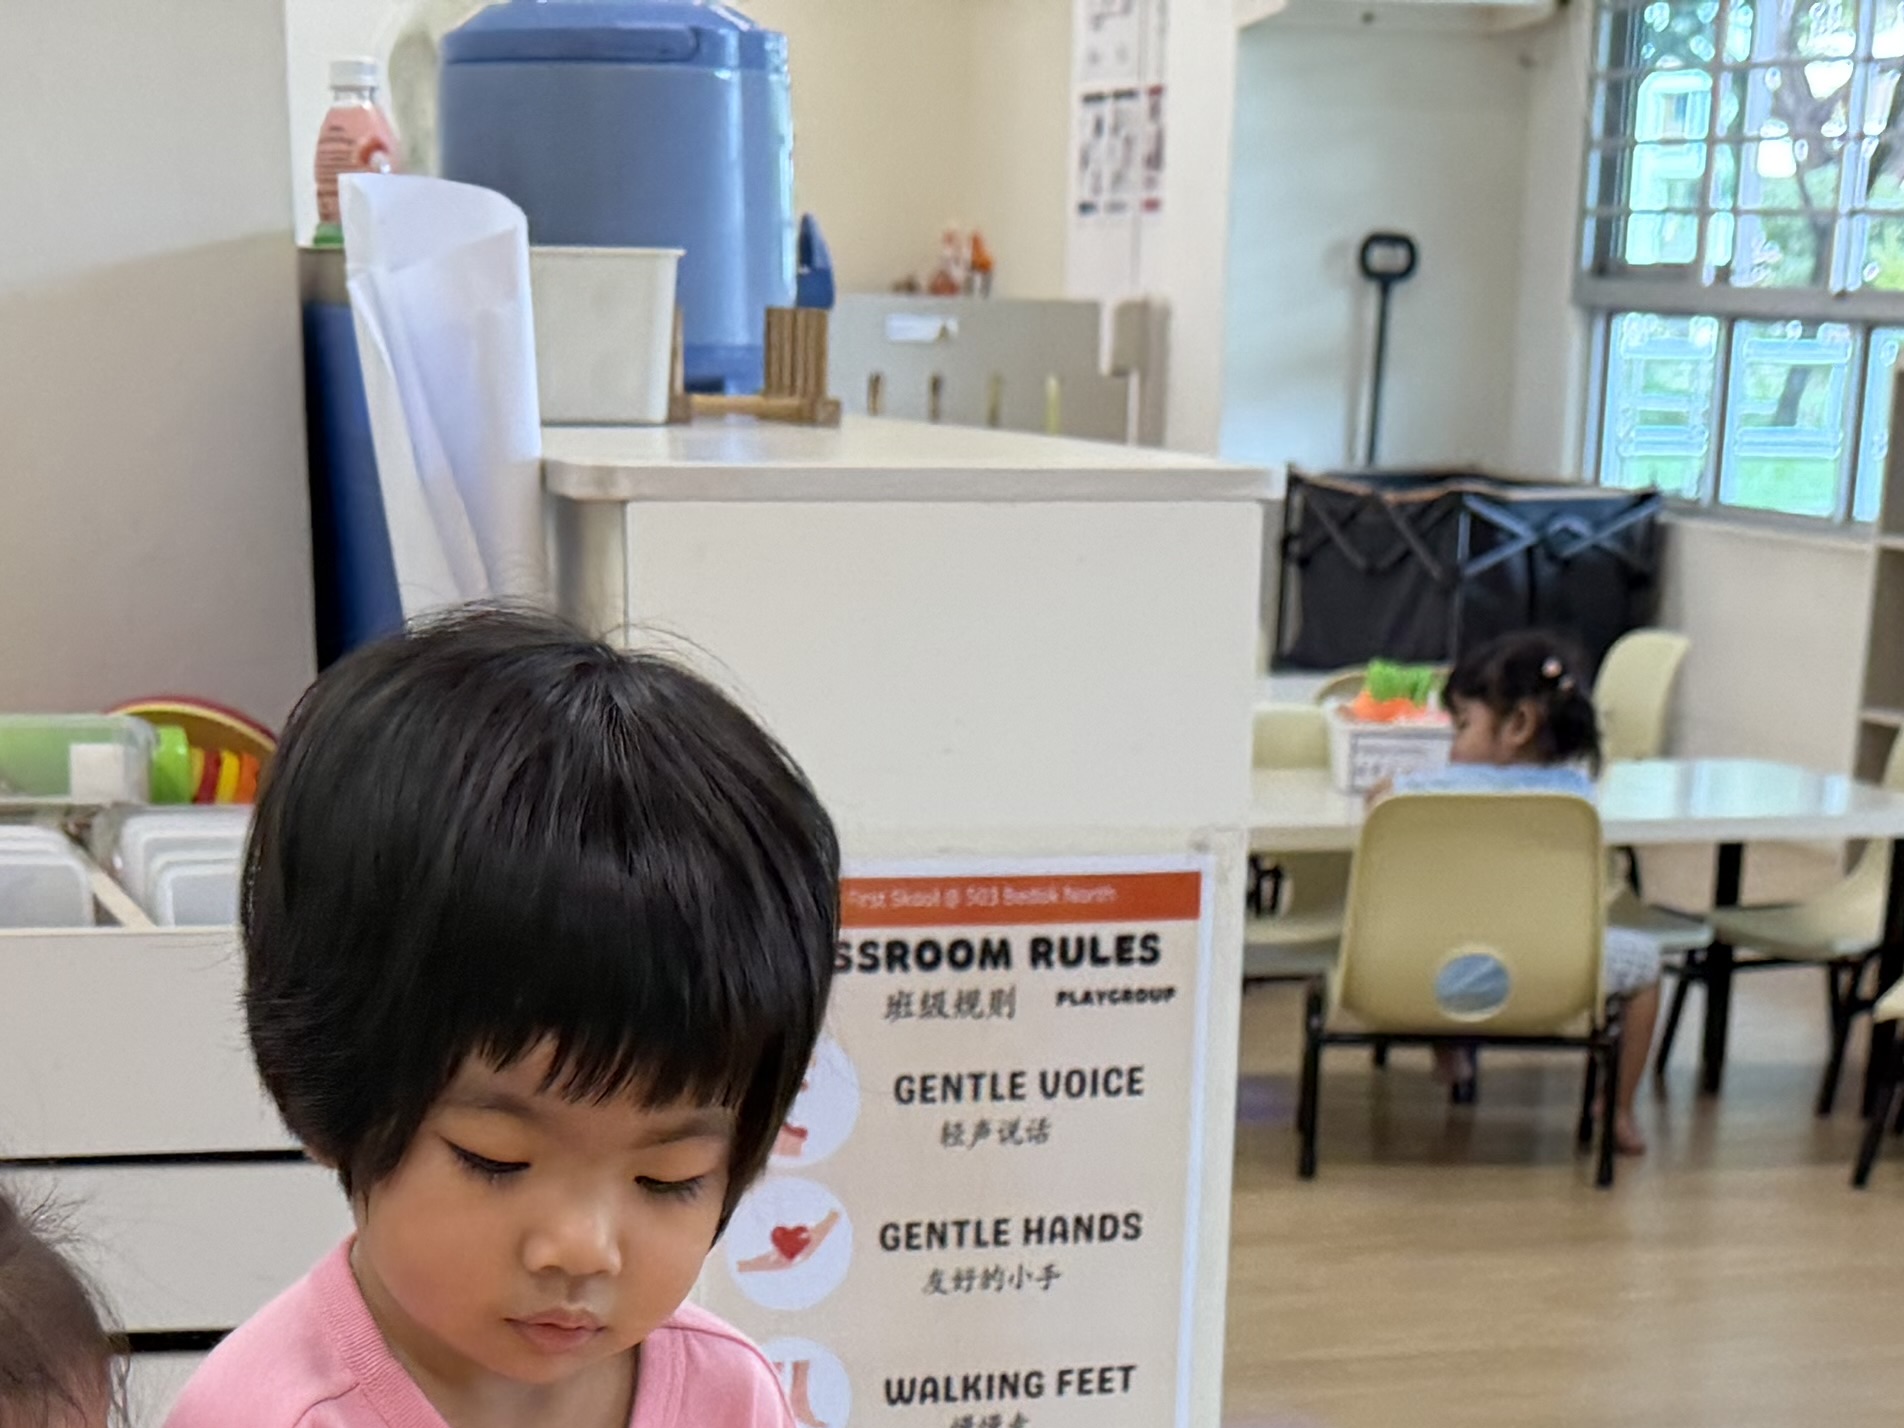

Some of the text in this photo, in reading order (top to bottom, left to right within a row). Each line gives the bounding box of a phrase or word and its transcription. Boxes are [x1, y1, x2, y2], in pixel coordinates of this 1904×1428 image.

[833, 933, 1162, 975] SSROOM RULES
[884, 984, 1017, 1022] 班级规则
[1054, 986, 1177, 1008] PLAYGROUP
[893, 1064, 1145, 1105] GENTLE VOICE
[879, 1210, 1144, 1252] GENTLE HANDS
[923, 1263, 1061, 1295] 友好的小手
[884, 1364, 1137, 1406] WALKING FEET
